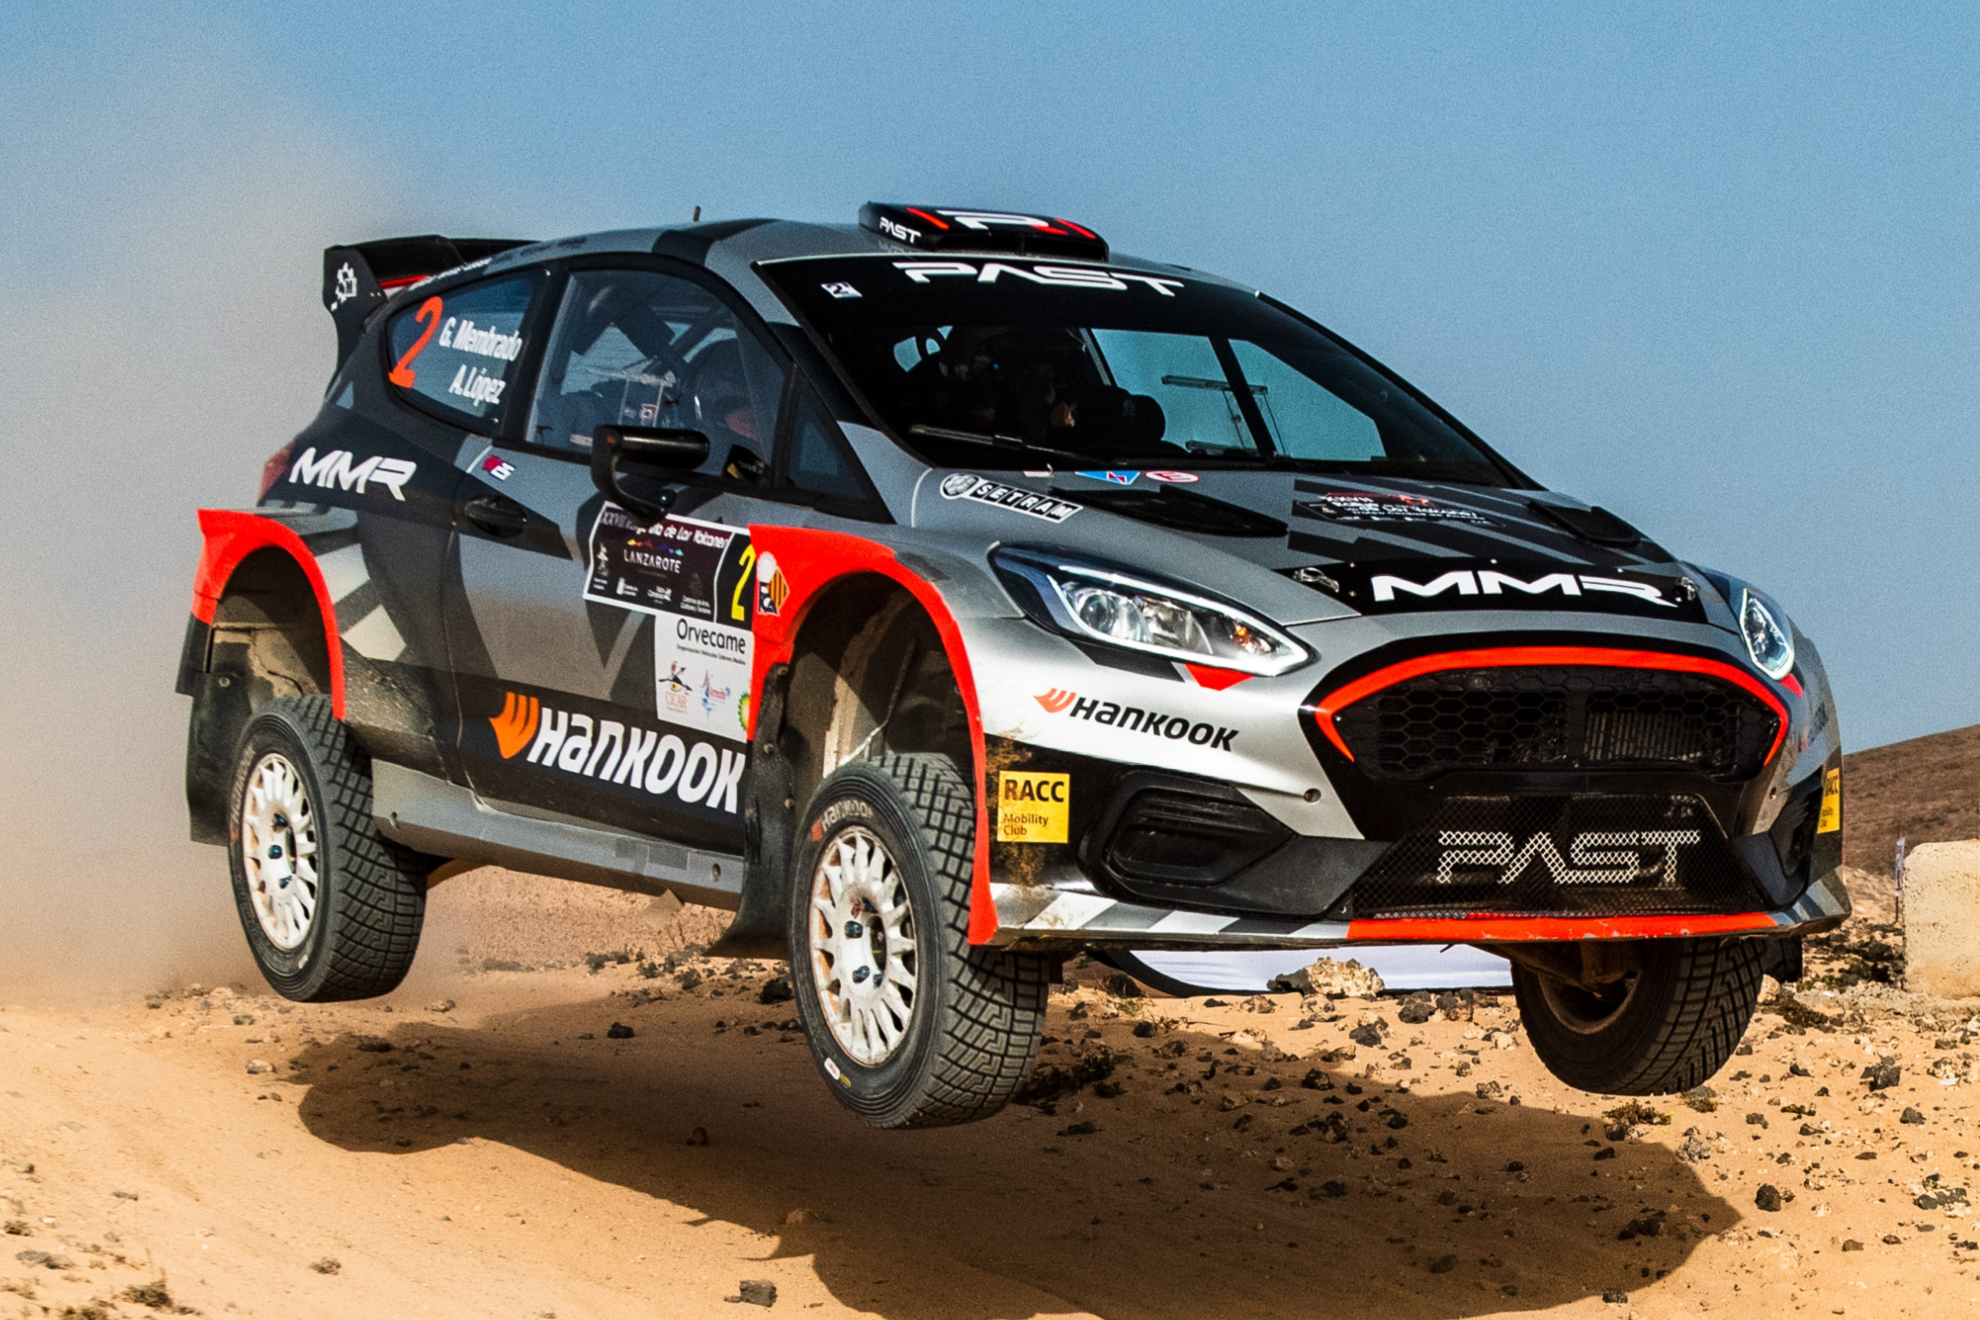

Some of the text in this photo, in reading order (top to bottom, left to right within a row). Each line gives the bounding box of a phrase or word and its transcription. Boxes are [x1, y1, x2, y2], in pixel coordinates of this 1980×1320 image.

[879, 217, 921, 243] PAST
[892, 262, 1185, 297] PAST
[388, 296, 443, 388] 2
[452, 319, 523, 361] Membrado
[288, 447, 417, 501] MMR
[975, 483, 1075, 520] SETRAM
[624, 549, 682, 573] LANZAROTE
[731, 544, 756, 621] 2
[1371, 570, 1679, 607] MMR
[677, 617, 746, 654] Orvecame
[1003, 779, 1064, 803] RACC
[1003, 813, 1049, 828] Mobility
[1003, 826, 1027, 836] Club
[1436, 831, 1700, 884] PAST
